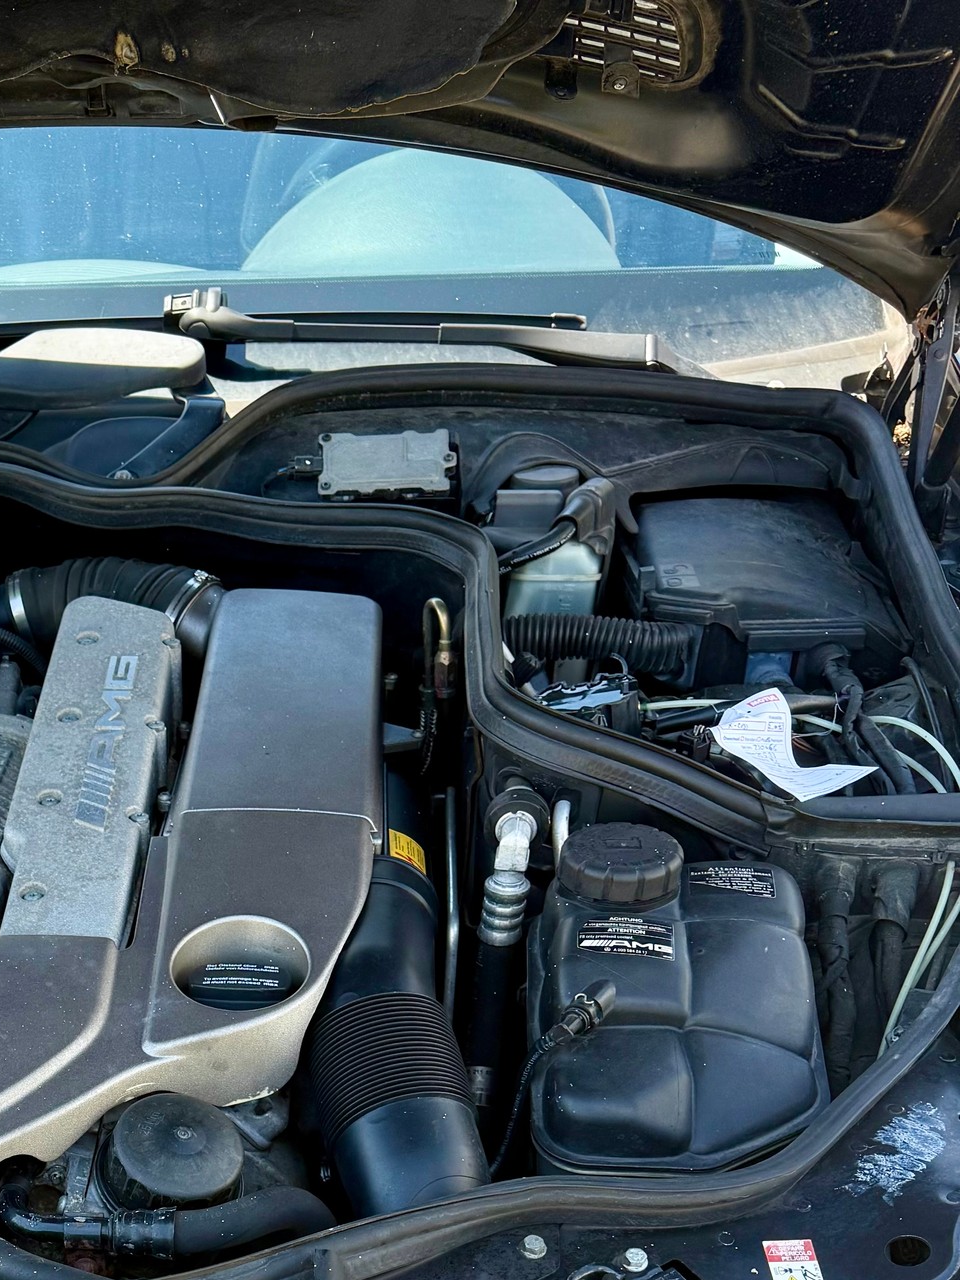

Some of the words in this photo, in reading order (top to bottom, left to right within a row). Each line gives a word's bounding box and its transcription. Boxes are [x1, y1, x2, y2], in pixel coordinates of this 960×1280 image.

[84, 655, 139, 772] AMG
[607, 927, 646, 935] ATTENTION
[609, 939, 673, 954] AMG
